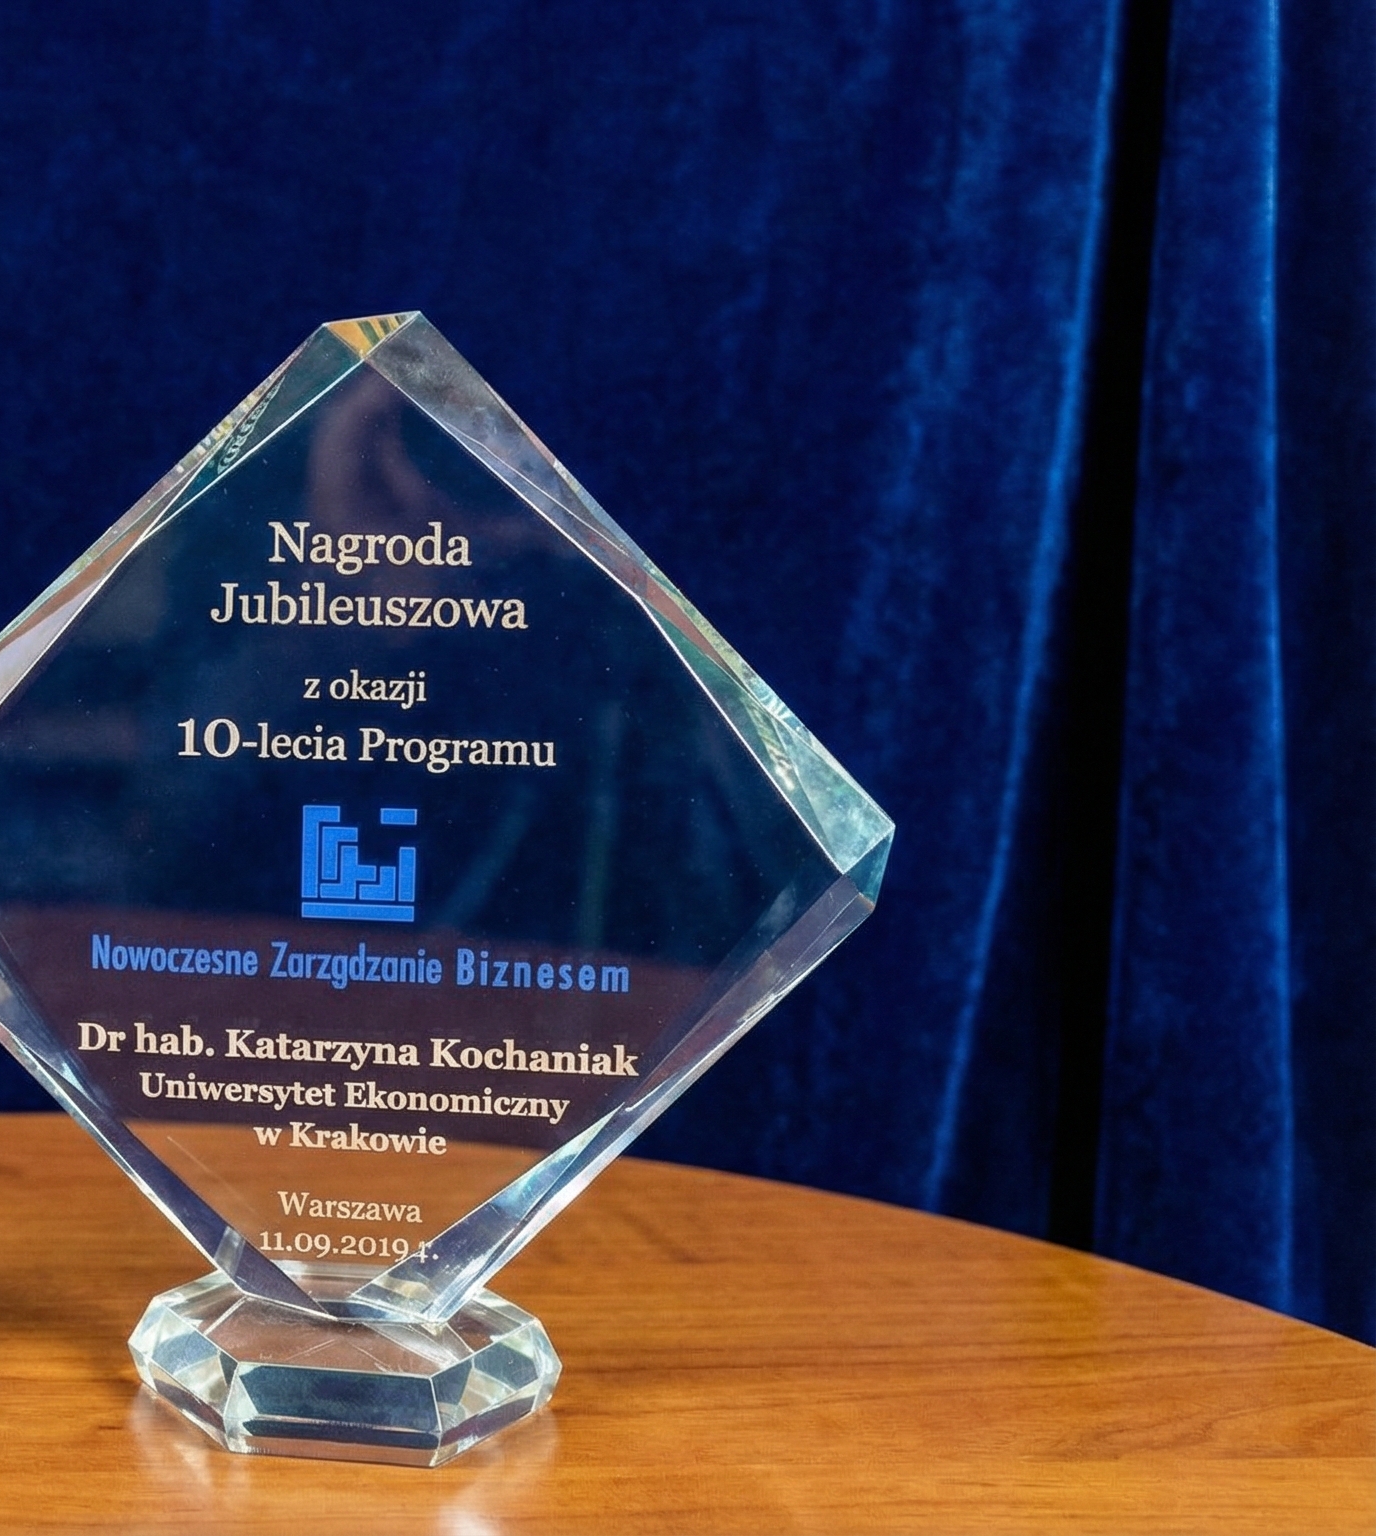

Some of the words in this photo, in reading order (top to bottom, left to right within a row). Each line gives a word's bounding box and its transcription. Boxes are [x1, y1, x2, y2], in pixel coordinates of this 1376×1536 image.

[268, 521, 472, 575] Nagroda
[210, 581, 528, 630] Jubileuszowa
[303, 679, 320, 700] z
[329, 669, 427, 710] okazji
[177, 717, 347, 762] 10-lecia
[358, 726, 557, 774] Programu
[91, 933, 259, 976] Nowoczesne
[456, 947, 630, 994] Biznesem
[78, 1021, 126, 1054] Dr
[135, 1023, 216, 1059] hab.
[224, 1028, 421, 1070] Katarzyna
[429, 1037, 640, 1078] Kochaniak
[139, 1071, 336, 1110] Uniwersytet
[343, 1081, 570, 1125] Ekonomiczny
[253, 1126, 283, 1147] w
[289, 1122, 448, 1156] Krakowie
[277, 1190, 423, 1225] Warszawa
[259, 1229, 409, 1262] 11.09.2019
